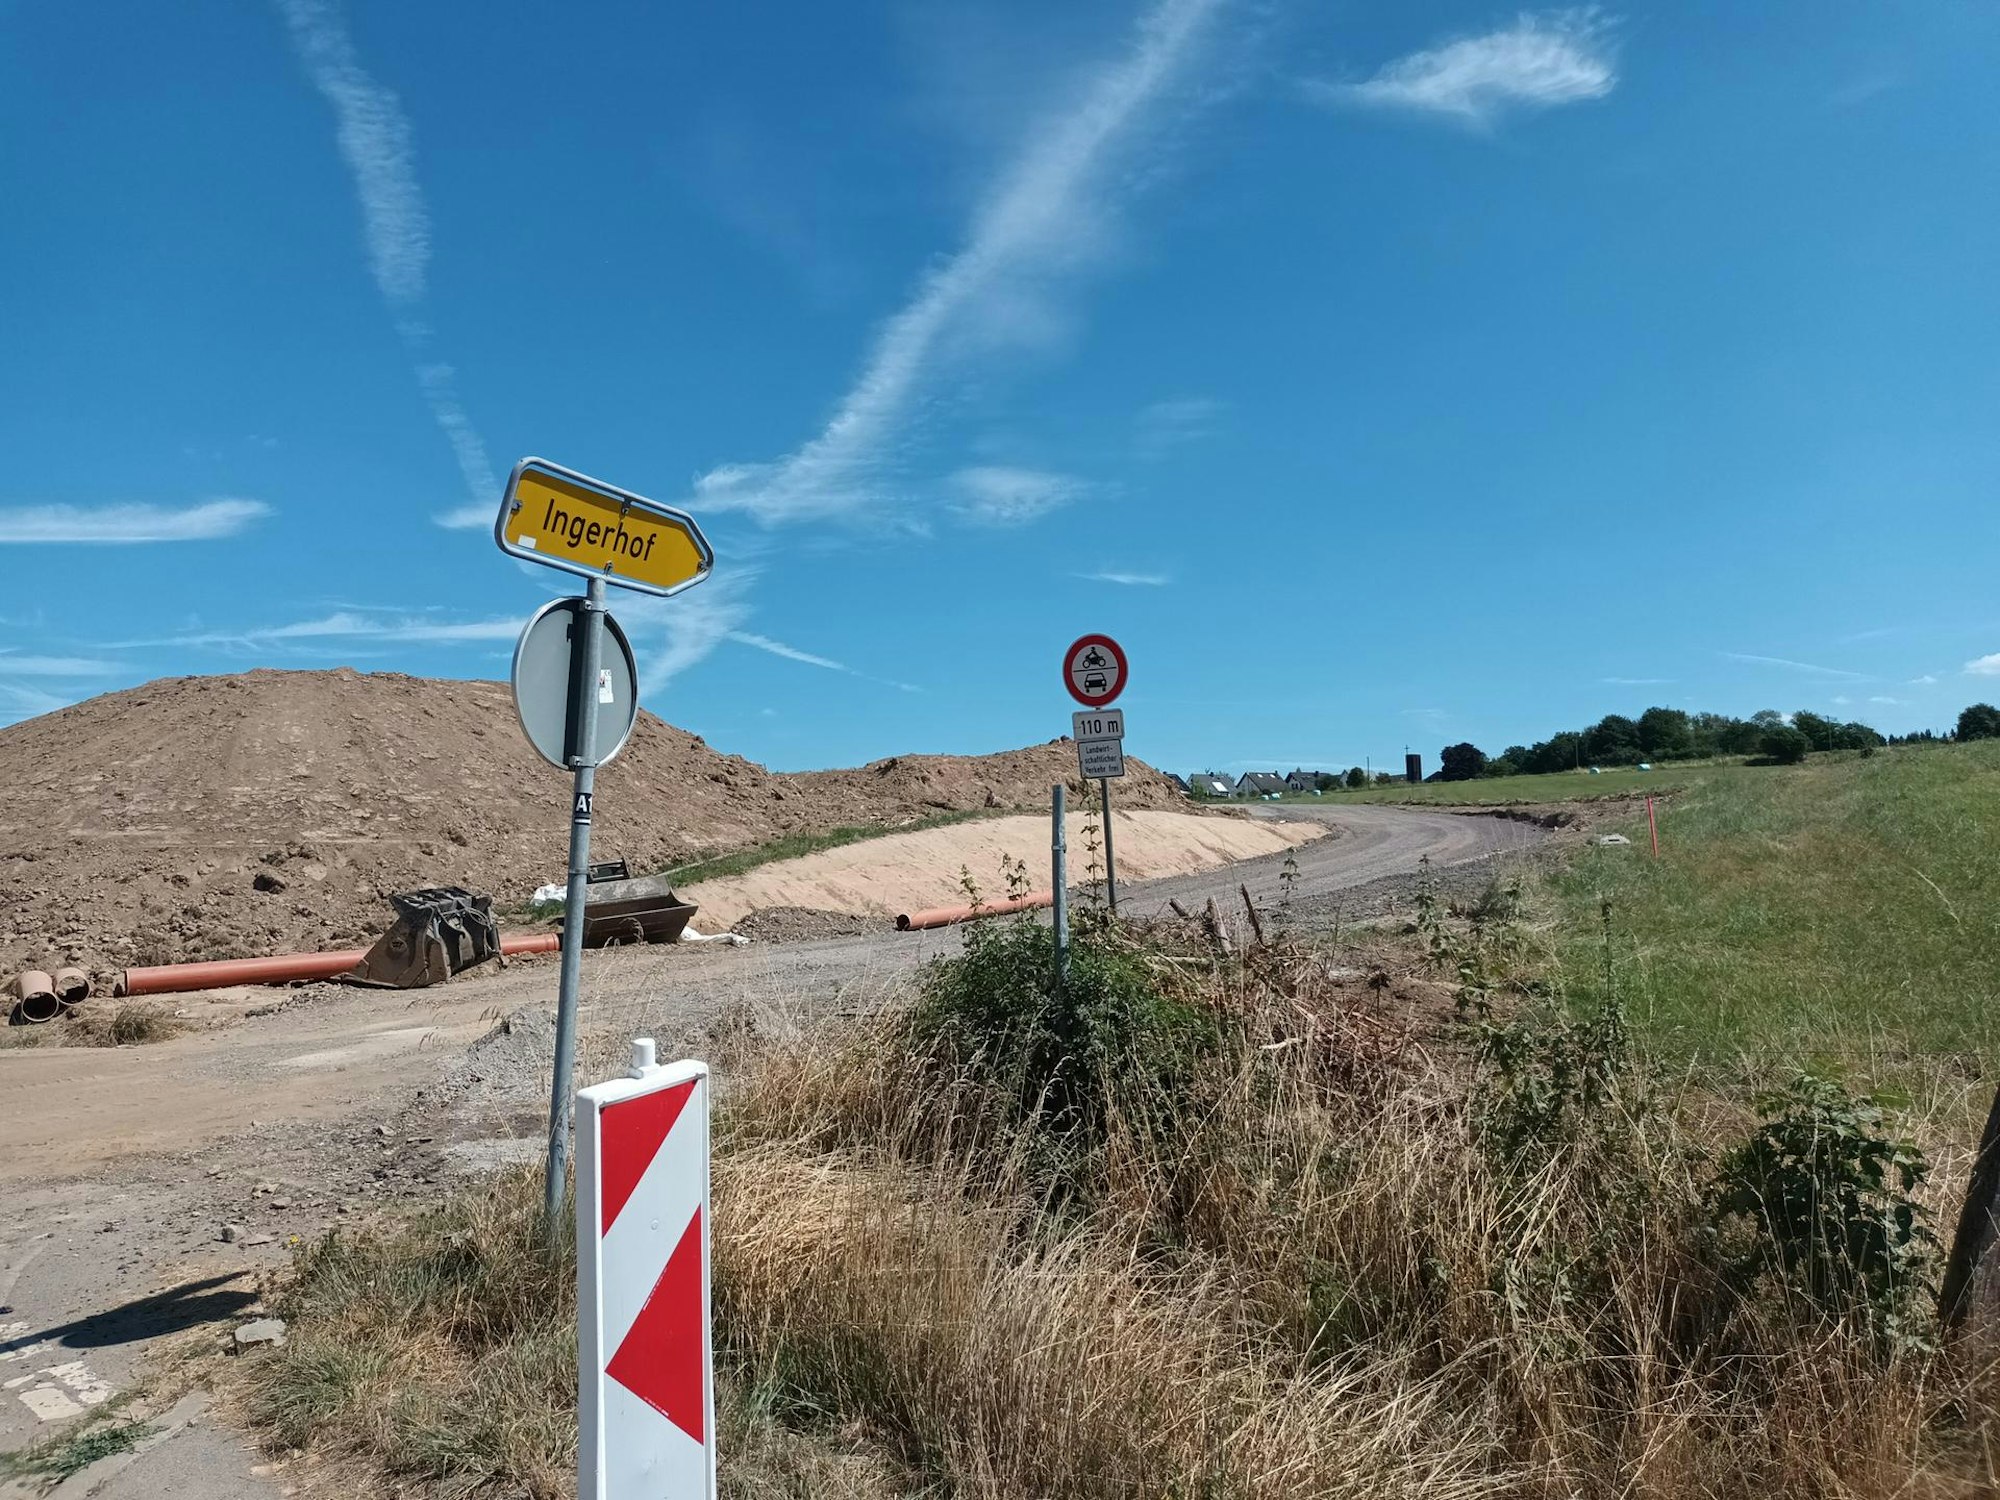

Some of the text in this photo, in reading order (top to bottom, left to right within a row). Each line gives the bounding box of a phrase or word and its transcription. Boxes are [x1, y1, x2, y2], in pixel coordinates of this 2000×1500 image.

[542, 498, 657, 561] Ingerhof
[1081, 719, 1119, 735] 110 m
